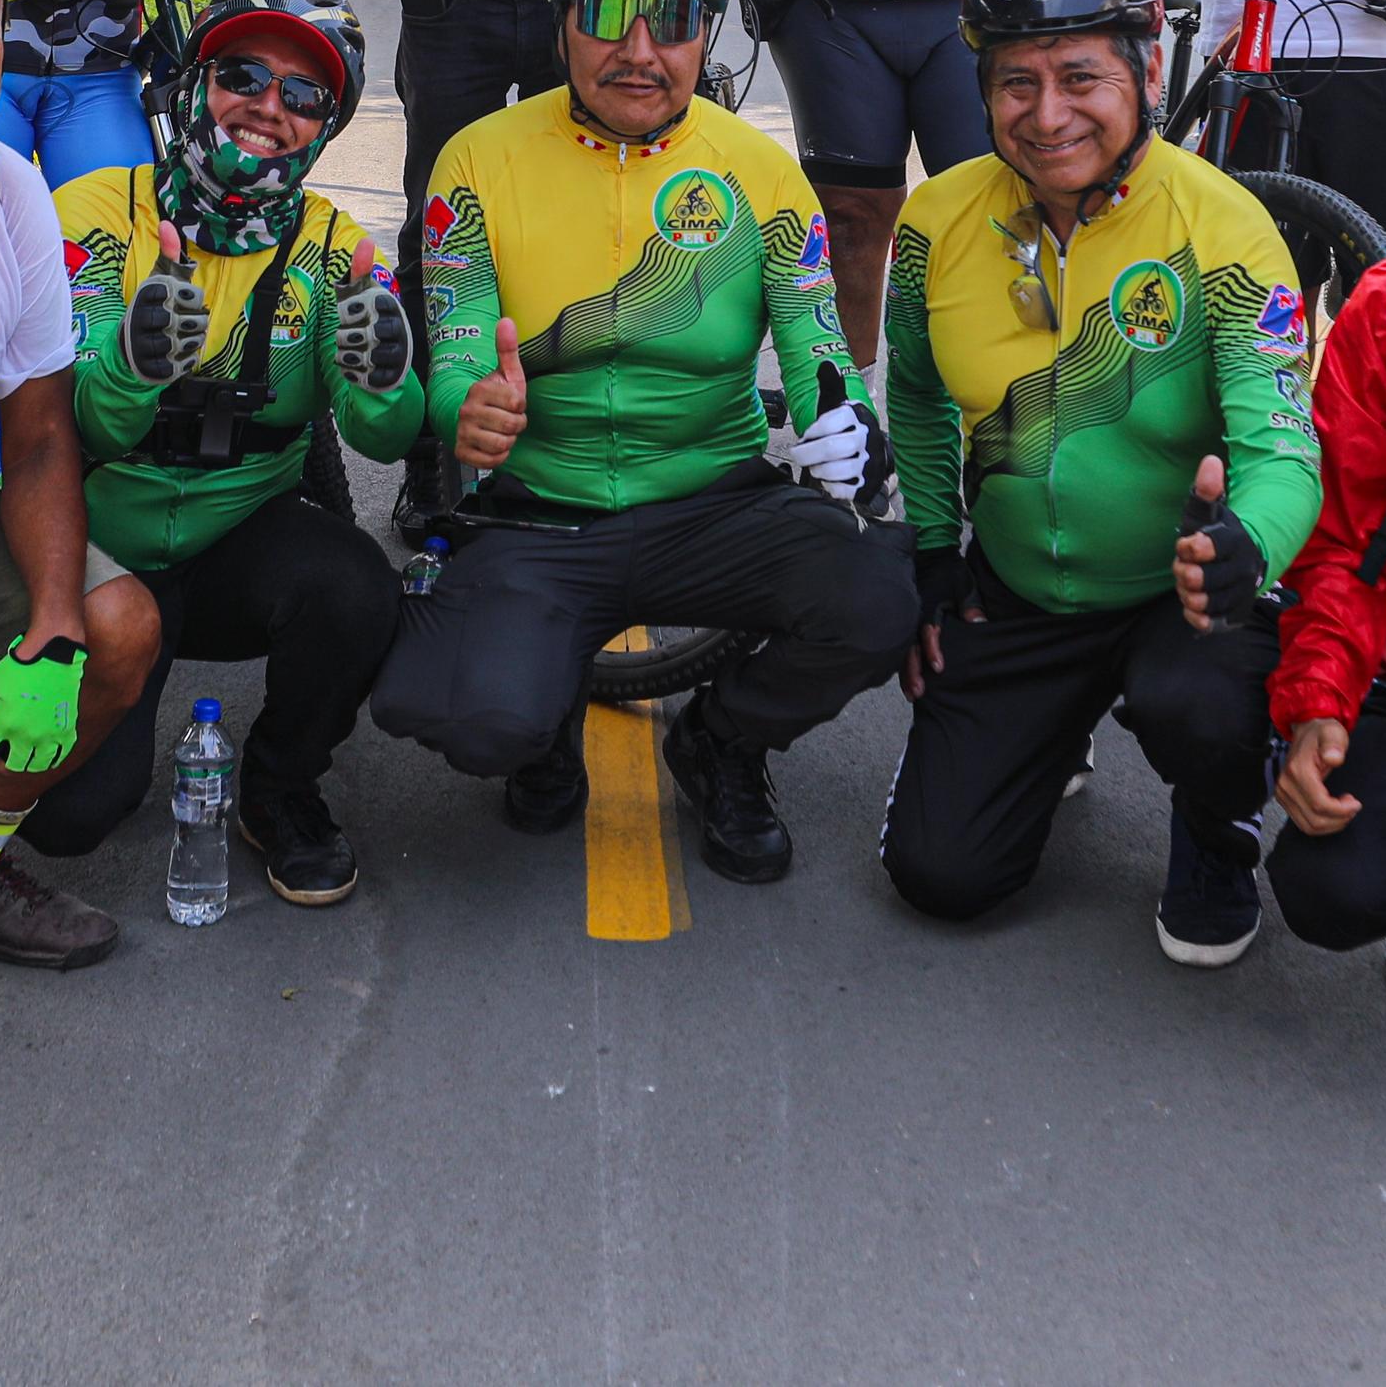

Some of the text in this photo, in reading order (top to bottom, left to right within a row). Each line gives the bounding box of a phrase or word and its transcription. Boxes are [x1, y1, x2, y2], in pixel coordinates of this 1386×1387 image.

[1253, 12, 1265, 59] TRINX
[667, 219, 722, 229] CIMA
[672, 228, 718, 246] PERÚ
[274, 314, 306, 325] MA
[1122, 312, 1172, 331] CIMA
[270, 323, 301, 341] ERÚ
